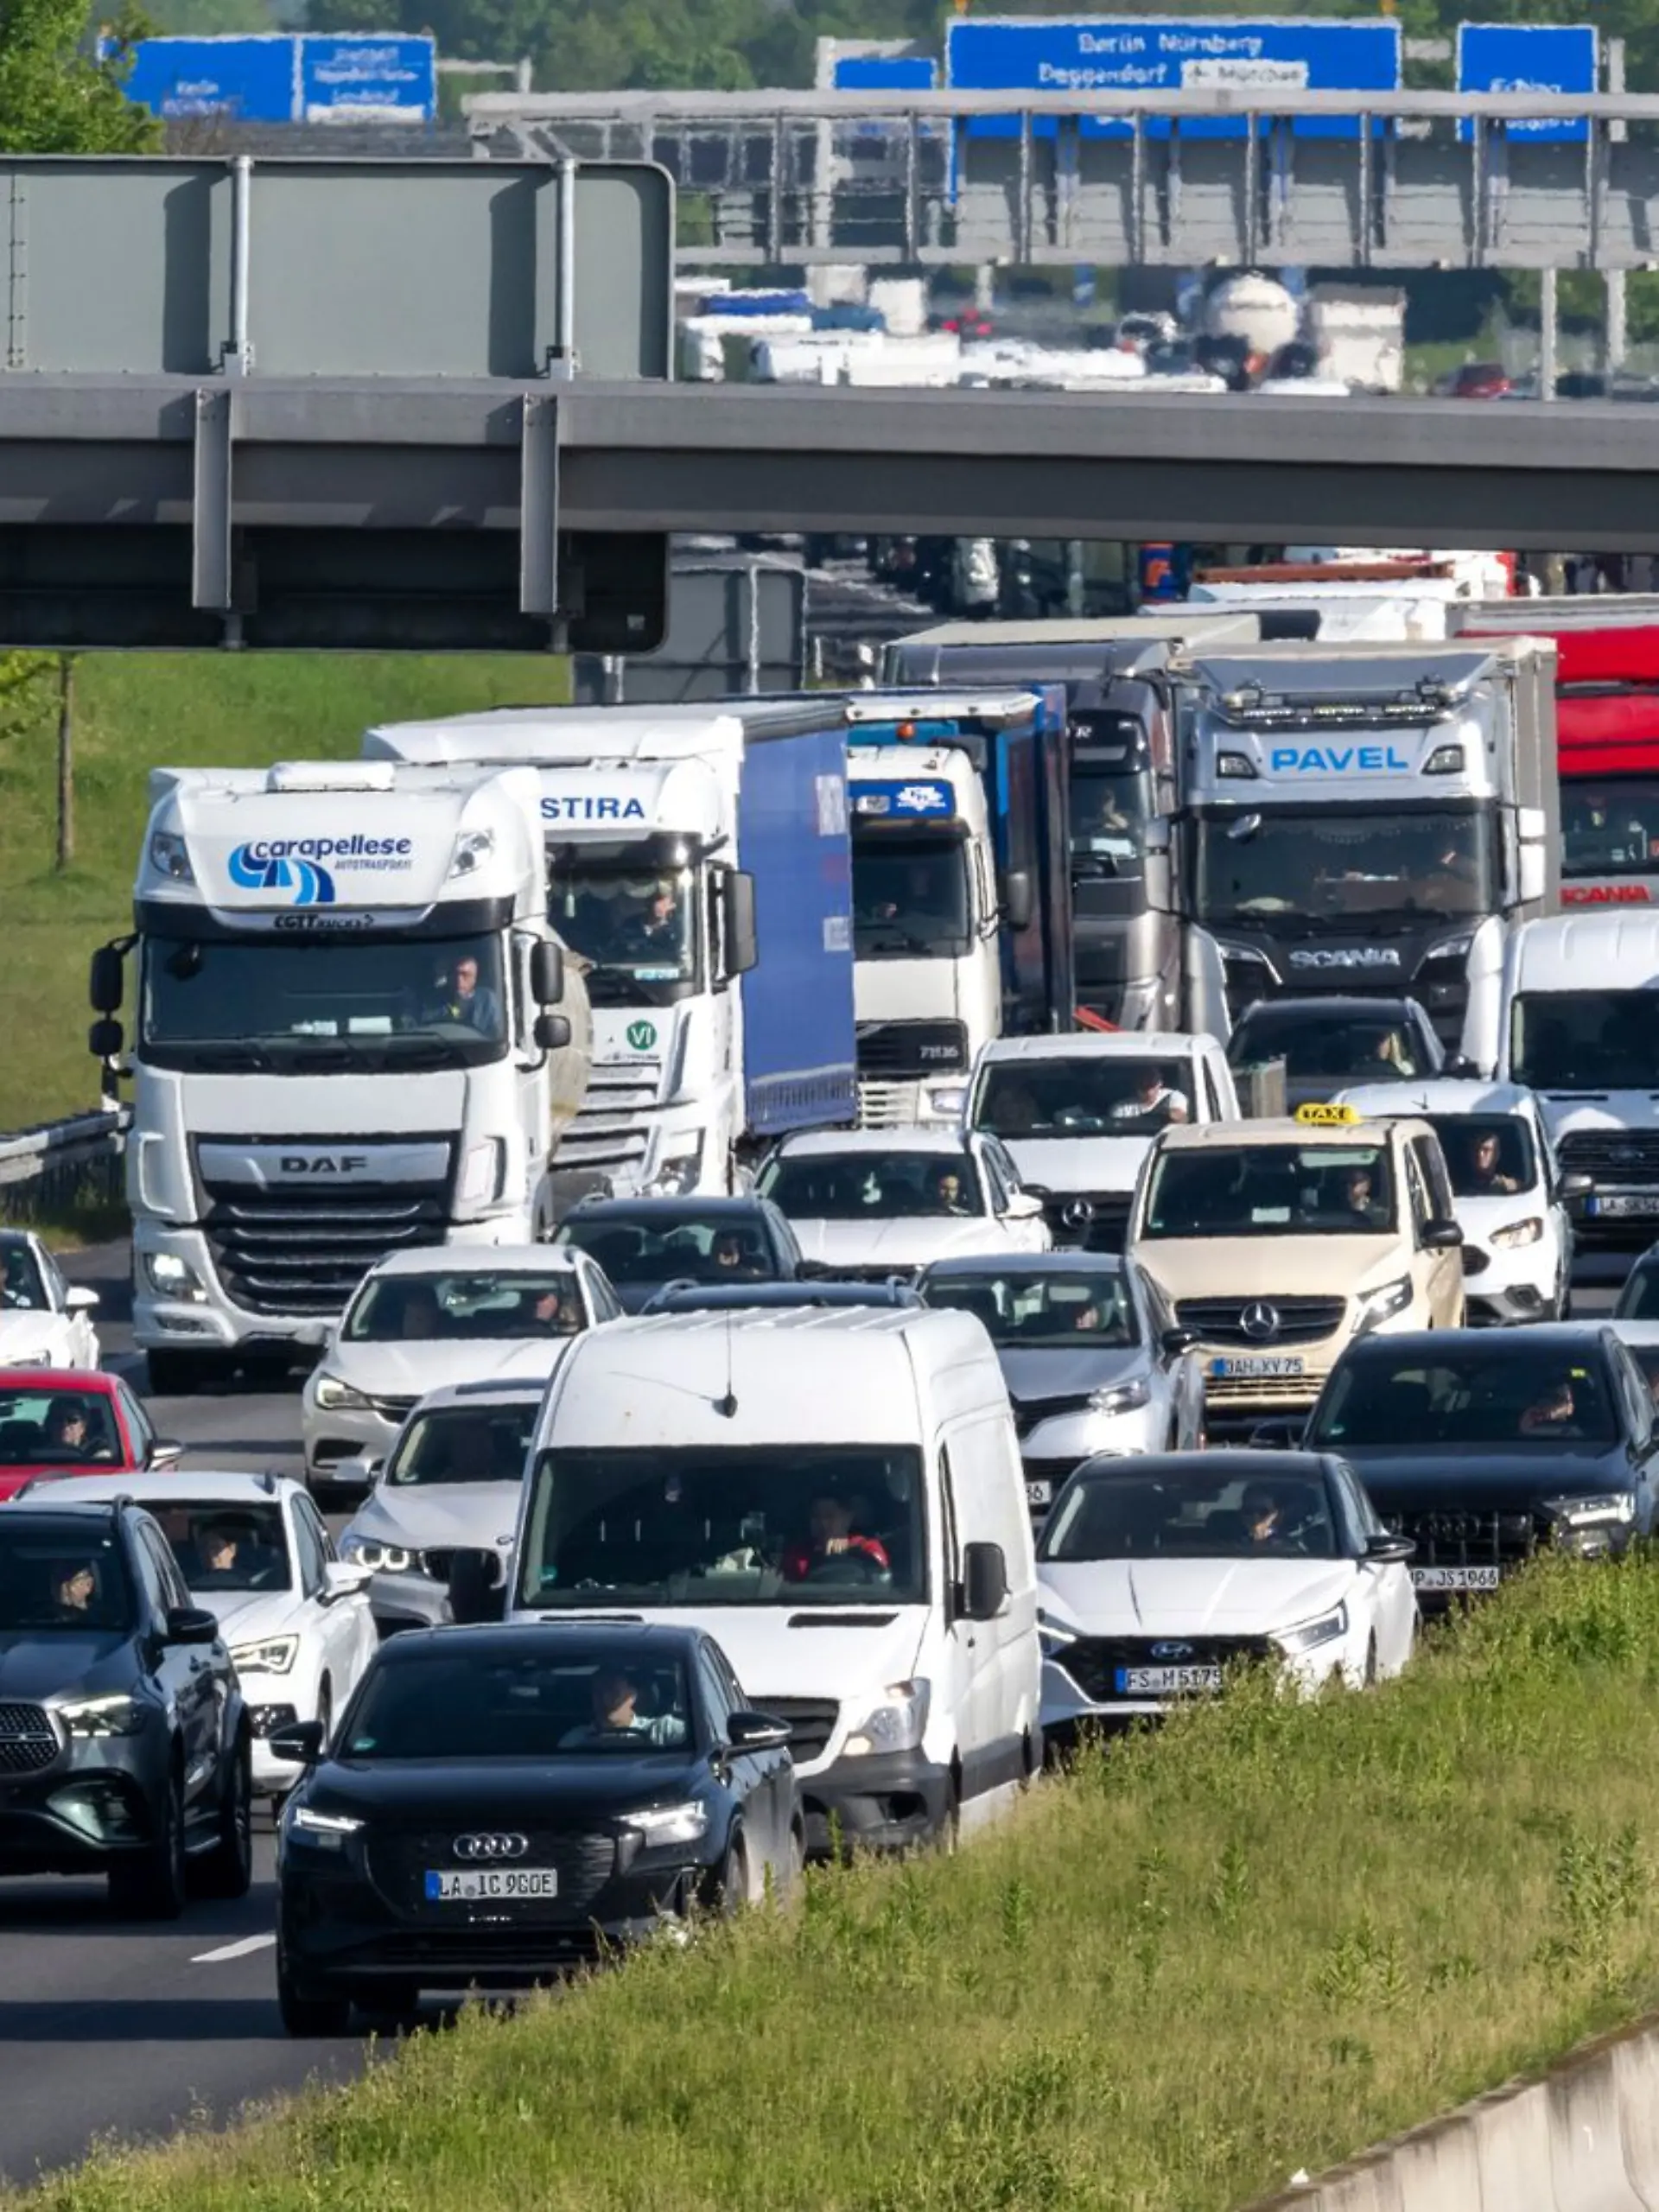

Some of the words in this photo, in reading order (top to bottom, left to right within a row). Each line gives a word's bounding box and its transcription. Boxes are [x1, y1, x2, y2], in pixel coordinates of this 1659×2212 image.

[1078, 33, 1145, 54] Berlin
[1159, 33, 1262, 57] Nürnberg
[1039, 62, 1166, 89] Deggendorf
[1272, 747, 1409, 771] PAVEL
[540, 797, 645, 819] STIRA
[255, 834, 412, 861] carapellese
[1289, 949, 1401, 967] SCANIA
[630, 1026, 652, 1045] VI
[1302, 1108, 1346, 1119] TAXI
[281, 1156, 368, 1173] DAF
[440, 1875, 461, 1896] LA
[478, 1874, 501, 1895] IC
